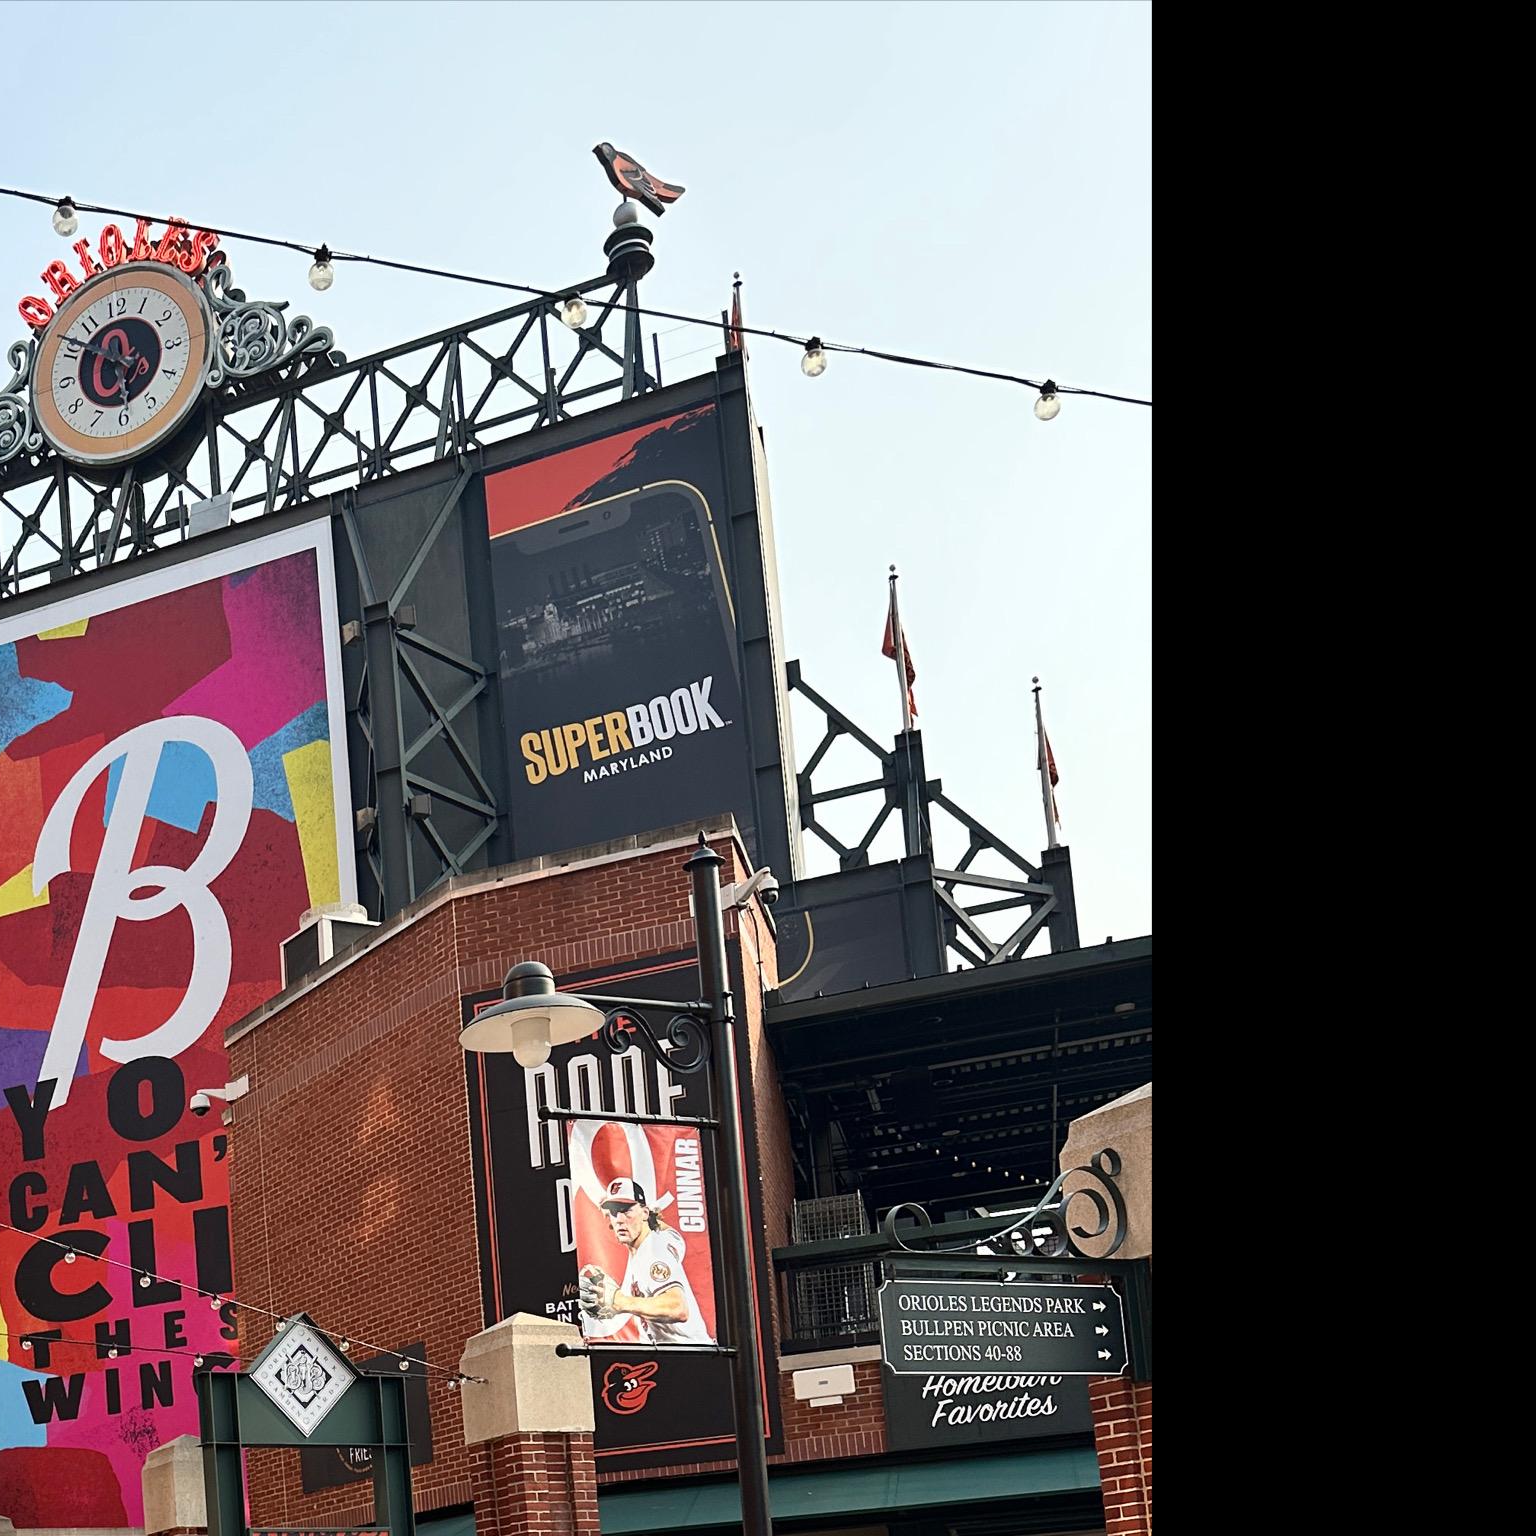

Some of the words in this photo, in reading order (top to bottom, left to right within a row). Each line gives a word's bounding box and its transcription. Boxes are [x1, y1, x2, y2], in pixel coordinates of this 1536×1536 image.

[18, 216, 221, 327] ORIOLES
[106, 298, 126, 319] 12
[137, 297, 148, 314] 1
[81, 316, 100, 336] 11
[155, 310, 173, 327] 2
[165, 336, 182, 350] 3
[58, 377, 76, 389] 9
[162, 368, 177, 381] 4
[68, 398, 84, 415] 8
[145, 393, 157, 410] 5
[90, 409, 104, 428] 7
[118, 408, 130, 427] 6
[520, 676, 725, 785] SUPERBOOK
[583, 746, 673, 784] MARYLAND
[32, 715, 254, 1110] B
[3, 1056, 185, 1162] YO
[8, 1135, 227, 1232] CAN'
[674, 1138, 706, 1233] GUNNAR
[15, 1205, 234, 1322] CLI
[562, 1282, 578, 1296] Ne
[898, 1295, 968, 1312] ORIOLES
[971, 1297, 1043, 1313] LEGENDS
[1046, 1299, 1086, 1314] PARK
[20, 1303, 238, 1369] THES
[901, 1320, 974, 1336] BULLPEN
[978, 1321, 1030, 1337] PICNIC
[1032, 1322, 1075, 1338] AREA
[904, 1345, 981, 1361] SECTIONS
[984, 1346, 1022, 1361] 40-88
[21, 1352, 235, 1424] WIN
[931, 1392, 1058, 1428] Favorites
